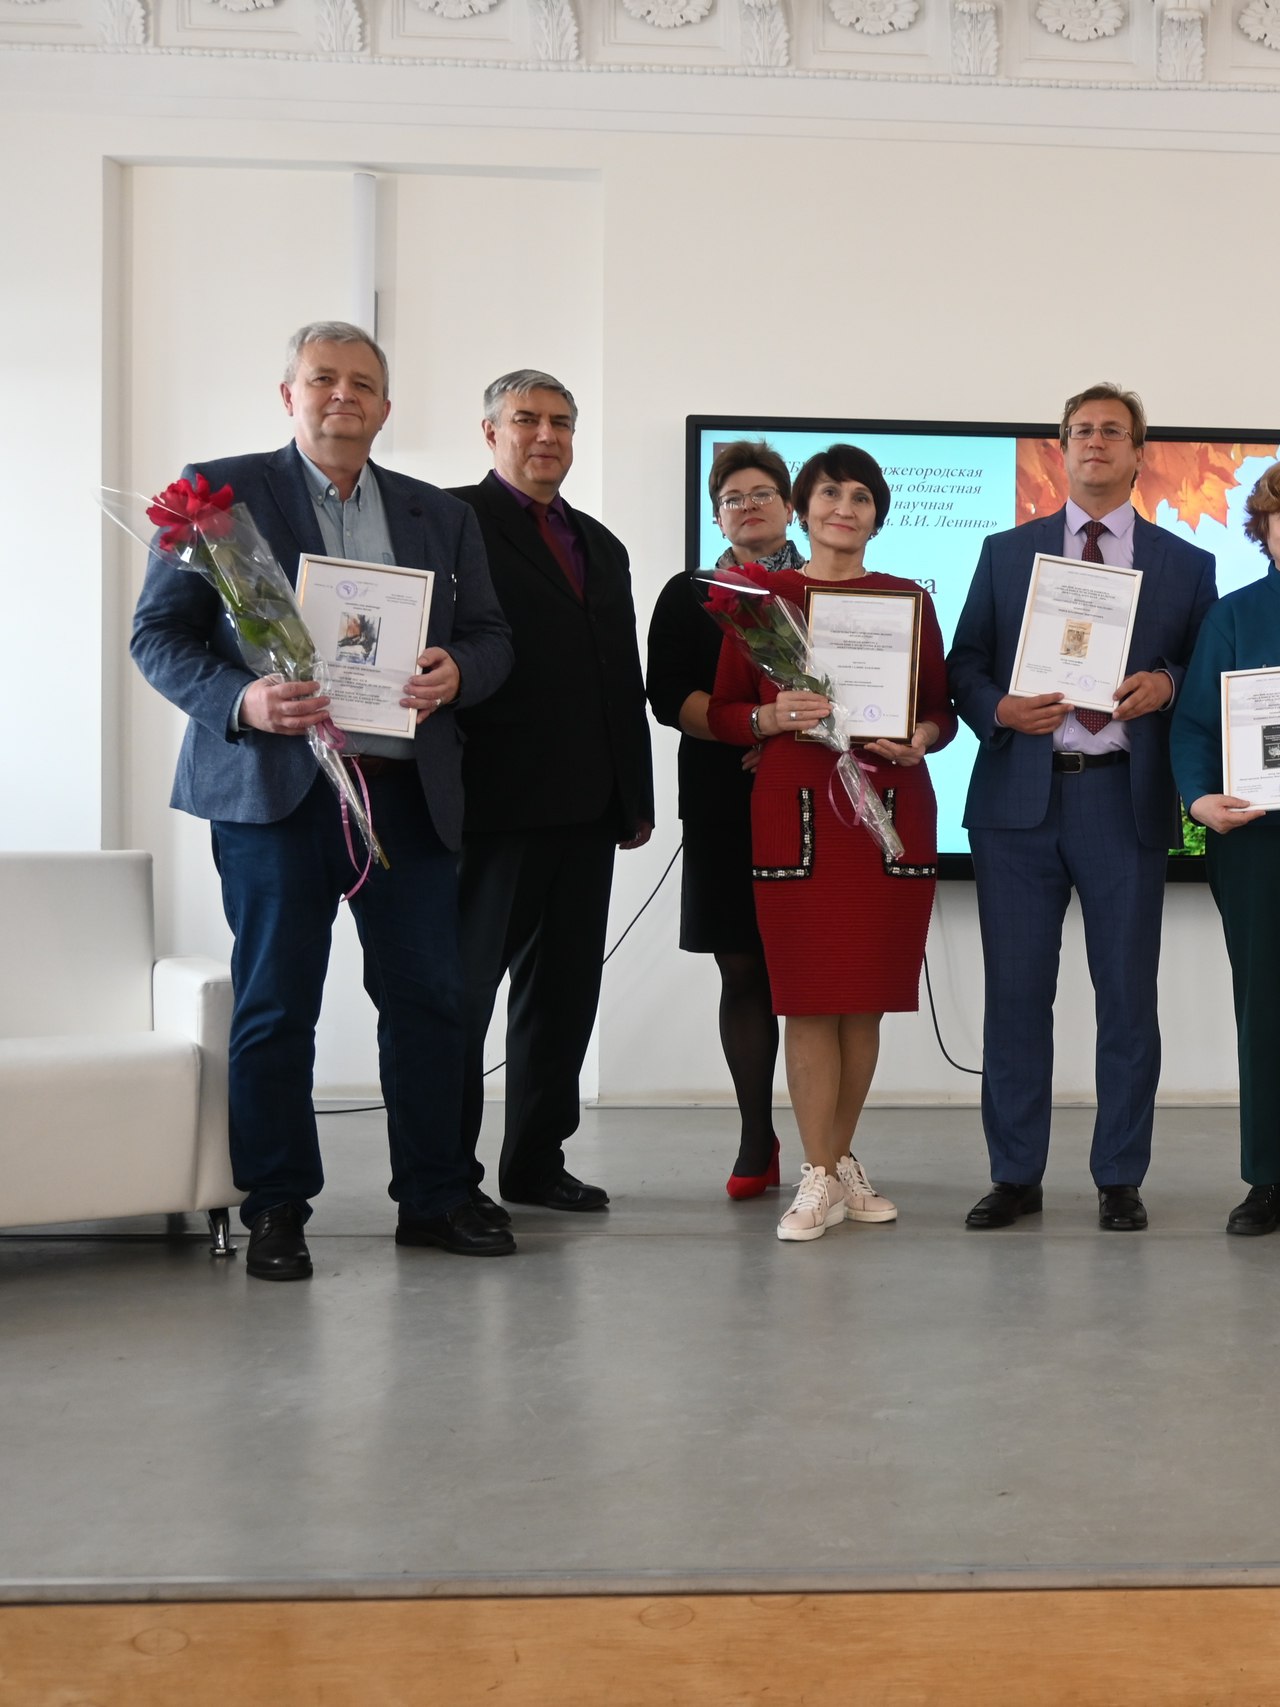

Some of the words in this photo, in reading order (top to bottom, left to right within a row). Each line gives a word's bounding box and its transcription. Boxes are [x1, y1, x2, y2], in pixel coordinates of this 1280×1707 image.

[880, 465, 983, 479] ижегородская
[907, 480, 982, 494] областная
[893, 500, 954, 513] научная
[900, 514, 929, 527] В.И.
[934, 515, 998, 529] Ленина»
